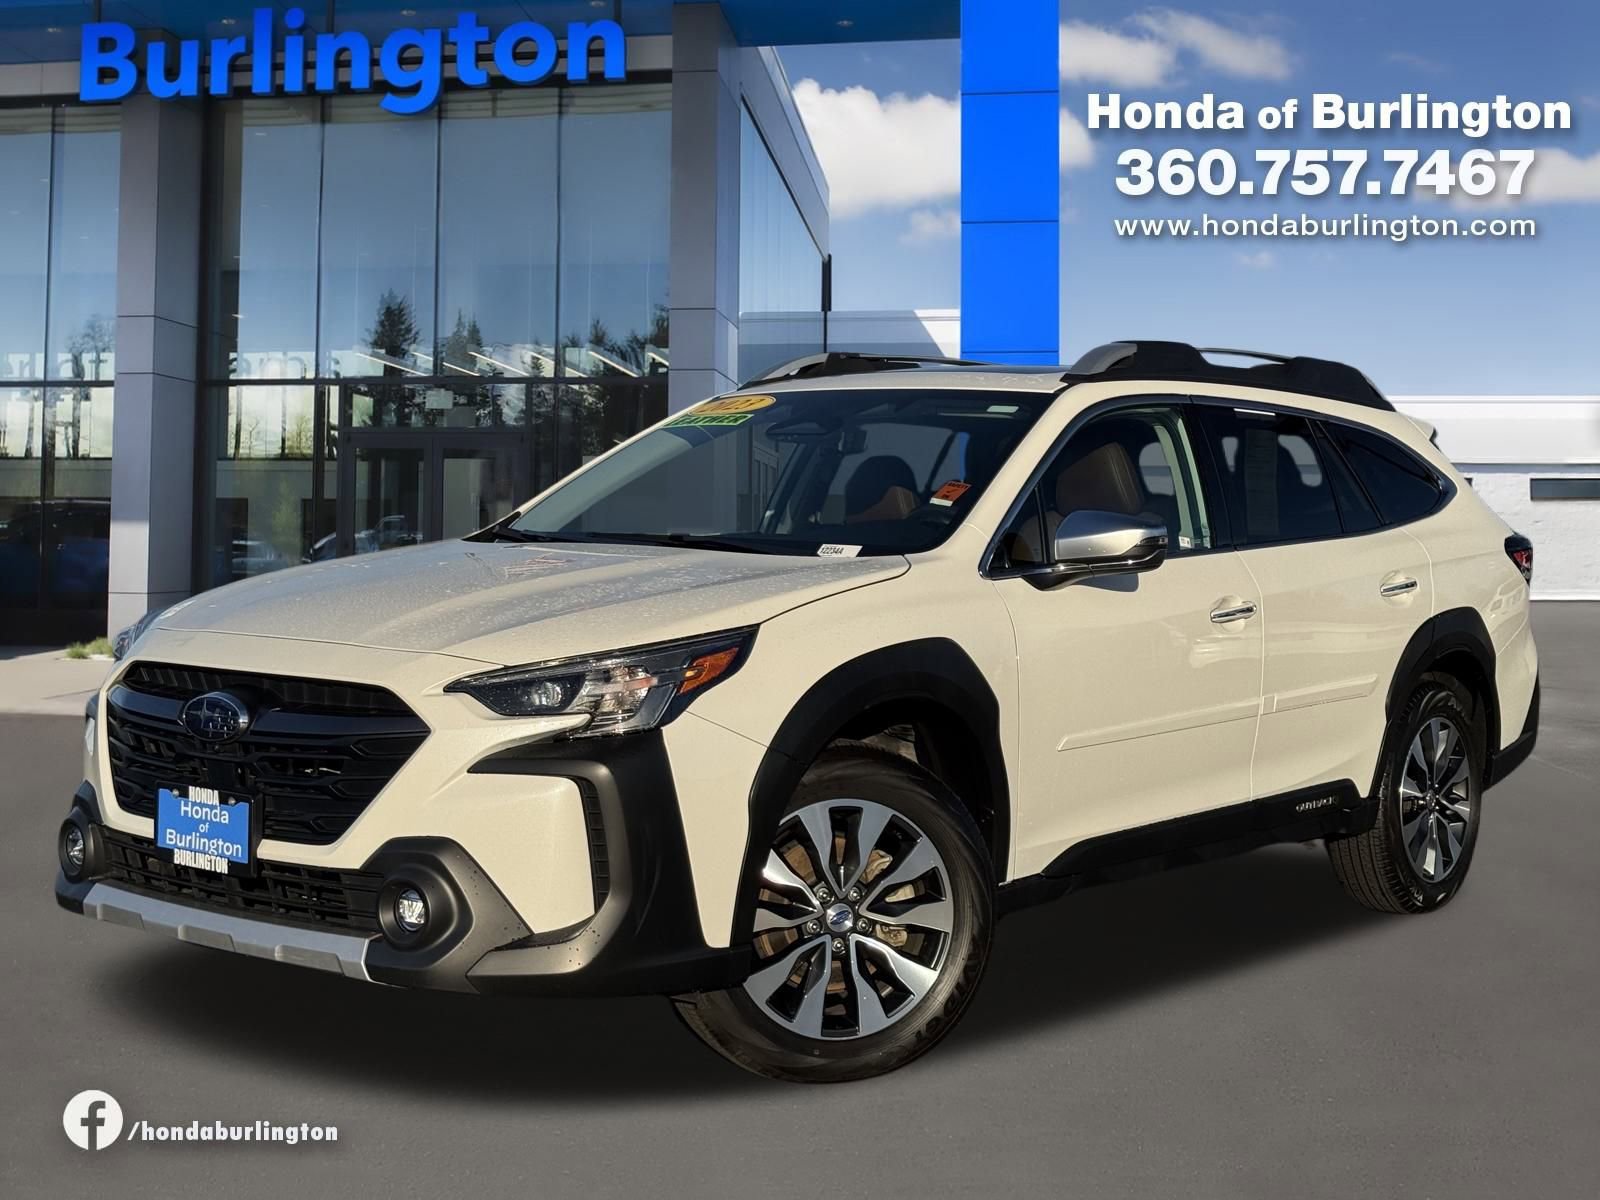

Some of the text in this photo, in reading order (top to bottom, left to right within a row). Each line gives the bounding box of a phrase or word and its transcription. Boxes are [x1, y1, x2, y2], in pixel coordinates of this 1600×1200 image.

[80, 7, 626, 115] Burlington
[188, 785, 220, 806] HONDA
[180, 800, 229, 824] Honda
[199, 822, 210, 833] of
[165, 828, 242, 858] Burlington
[173, 848, 229, 875] BURLINGTON
